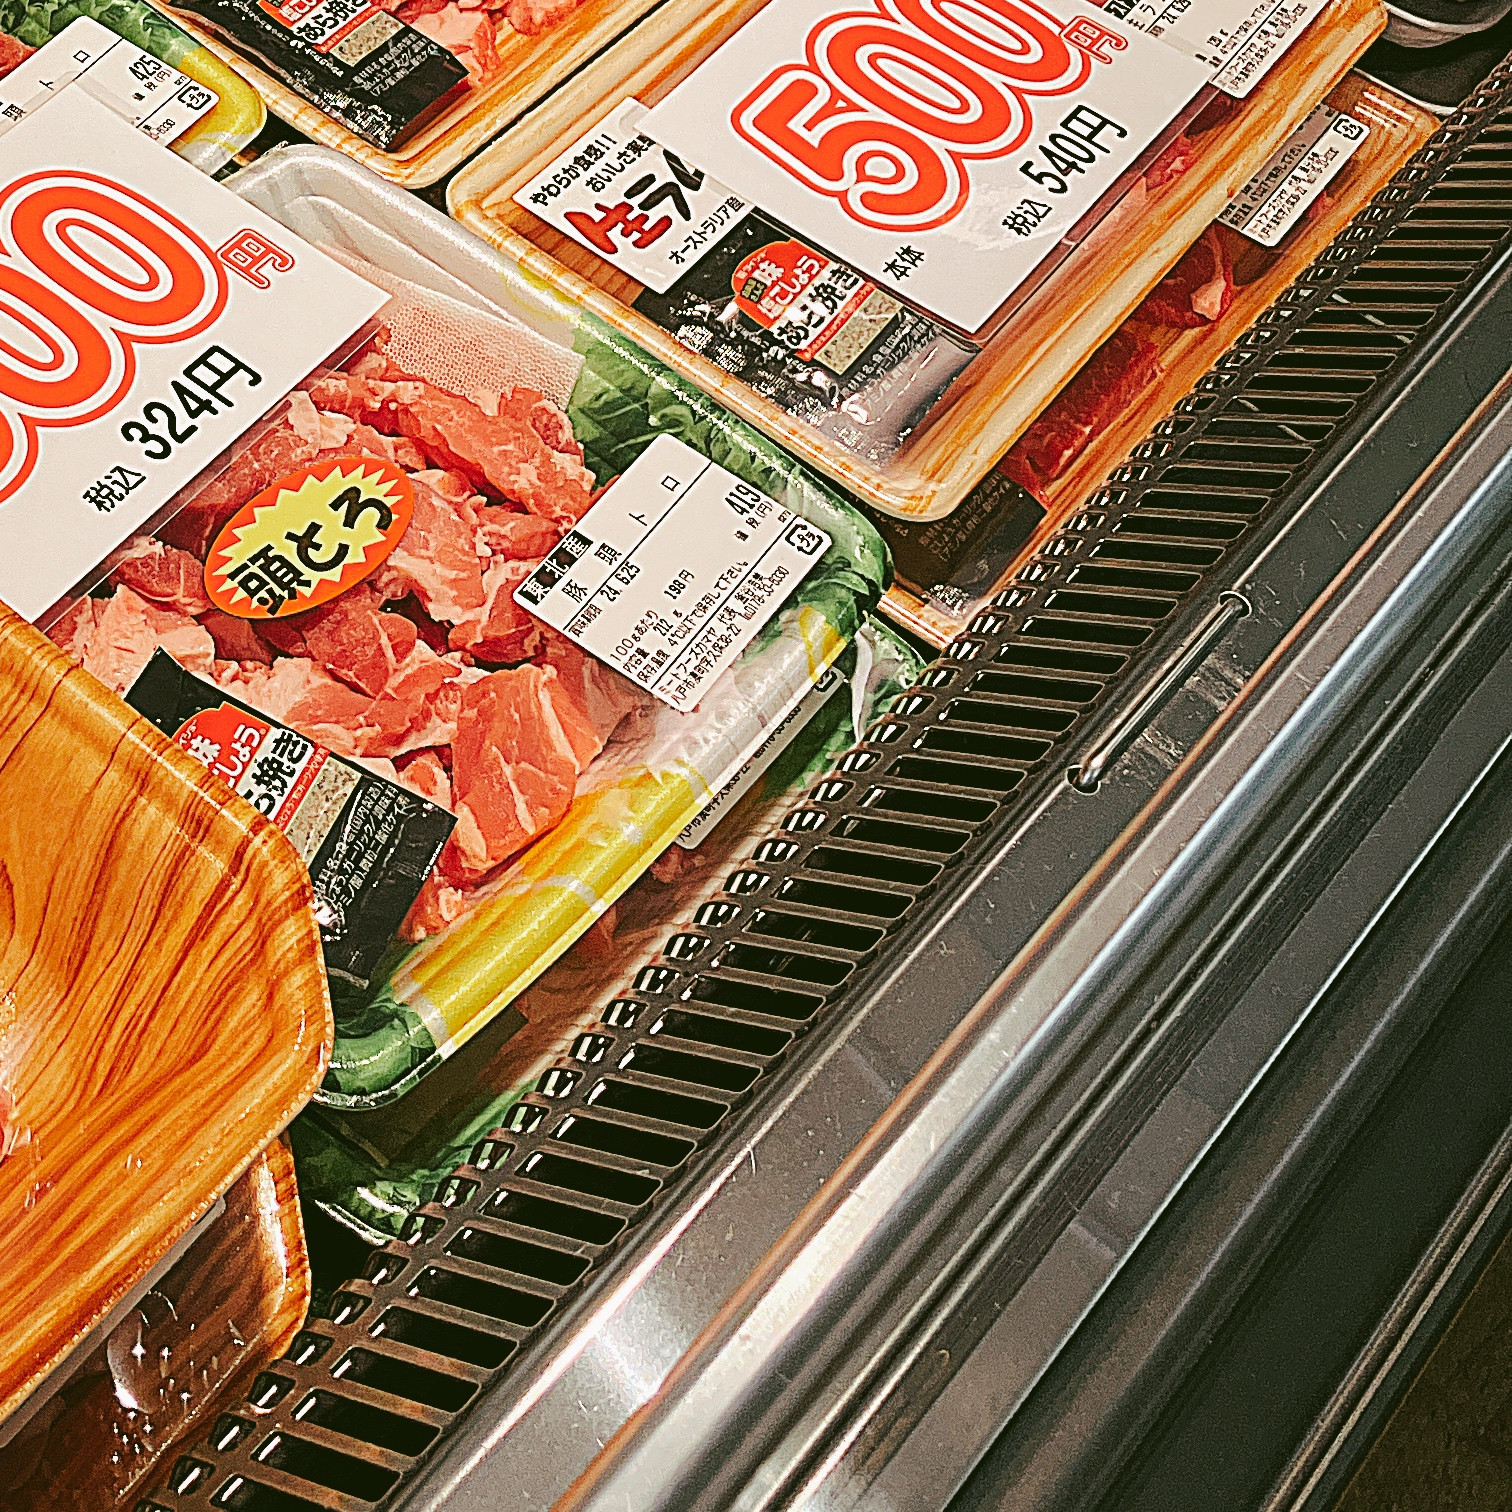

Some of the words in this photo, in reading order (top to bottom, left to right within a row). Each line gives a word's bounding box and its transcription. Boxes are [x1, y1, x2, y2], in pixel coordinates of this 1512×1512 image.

[129, 55, 162, 81] 425
[1019, 105, 1127, 194] 540円
[668, 196, 746, 266] オーストラリア産
[1002, 199, 1052, 236] 税込
[883, 245, 924, 280] 本体
[82, 466, 146, 512] 税込
[121, 345, 262, 462] 324円
[725, 484, 761, 515] 419
[236, 486, 397, 616] 頭とろ
[520, 530, 593, 605] 東北産
[664, 569, 694, 599] 198円
